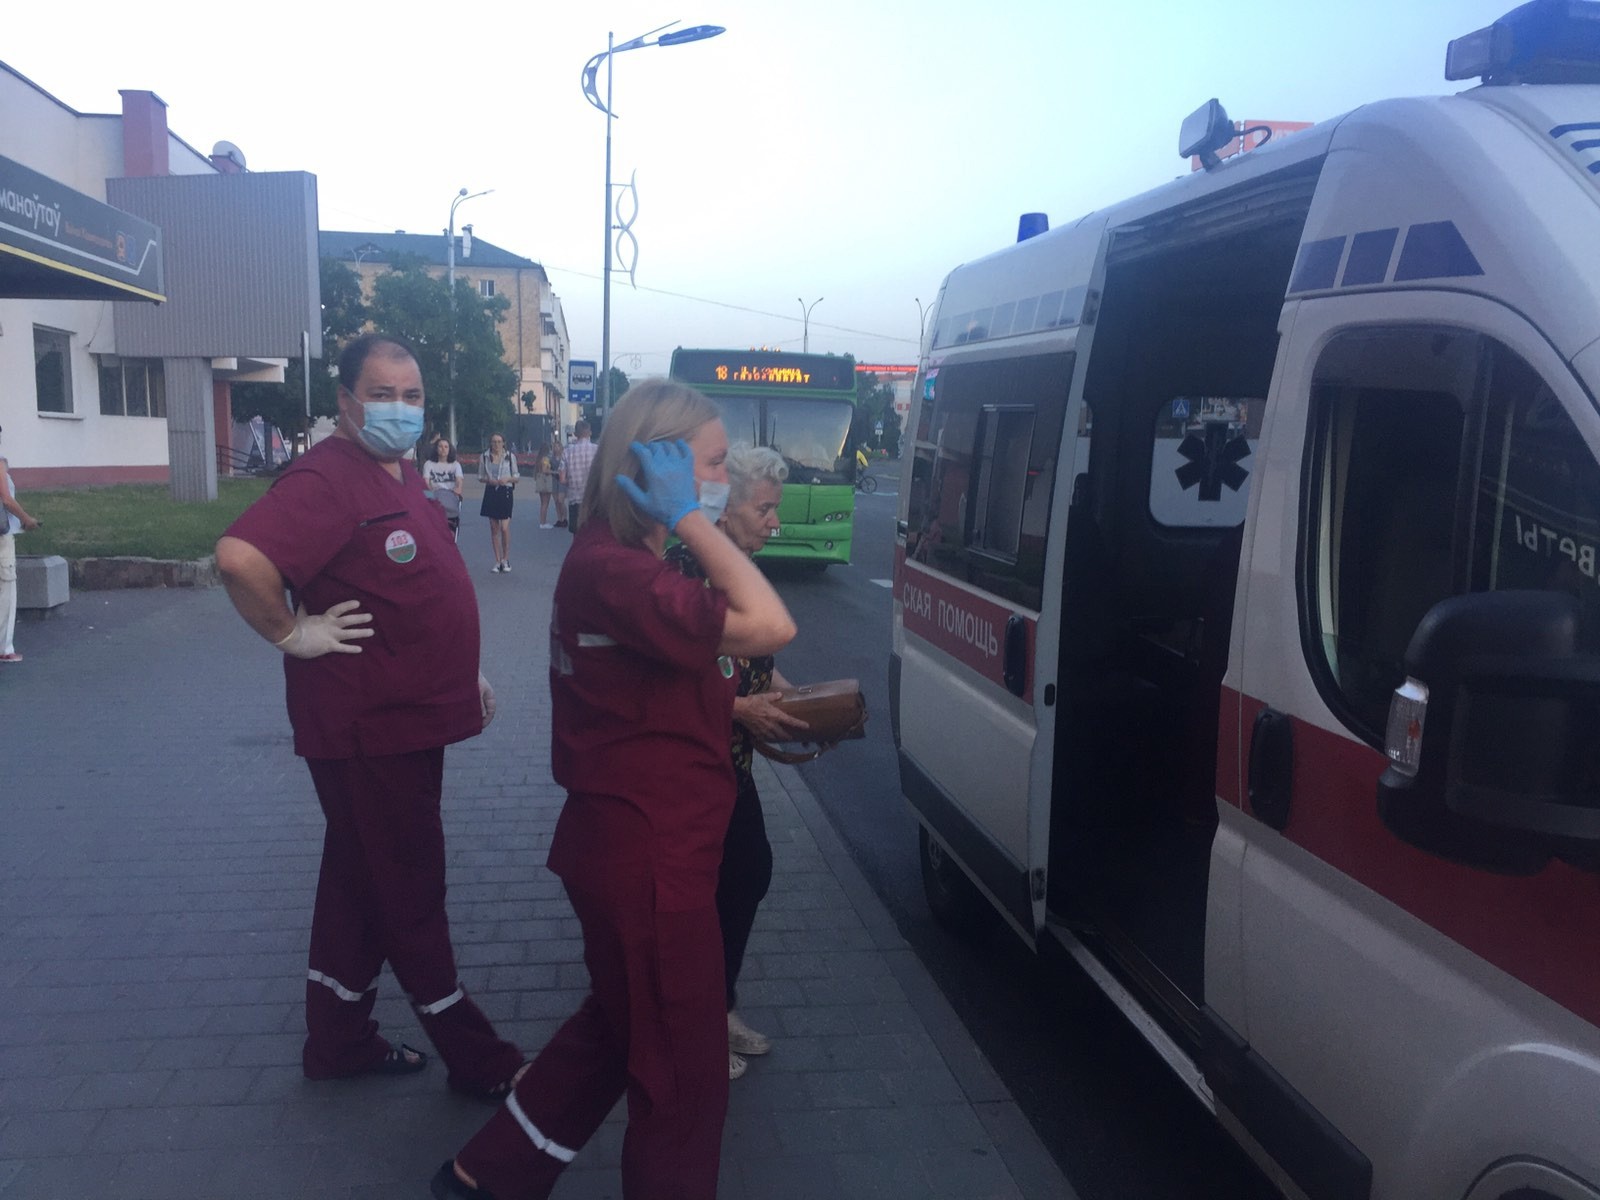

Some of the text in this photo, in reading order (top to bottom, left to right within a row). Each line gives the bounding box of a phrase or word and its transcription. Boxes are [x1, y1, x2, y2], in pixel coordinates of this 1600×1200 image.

[715, 364, 728, 381] 18
[903, 582, 998, 659] СКАЯ ПОМОЩЬ
